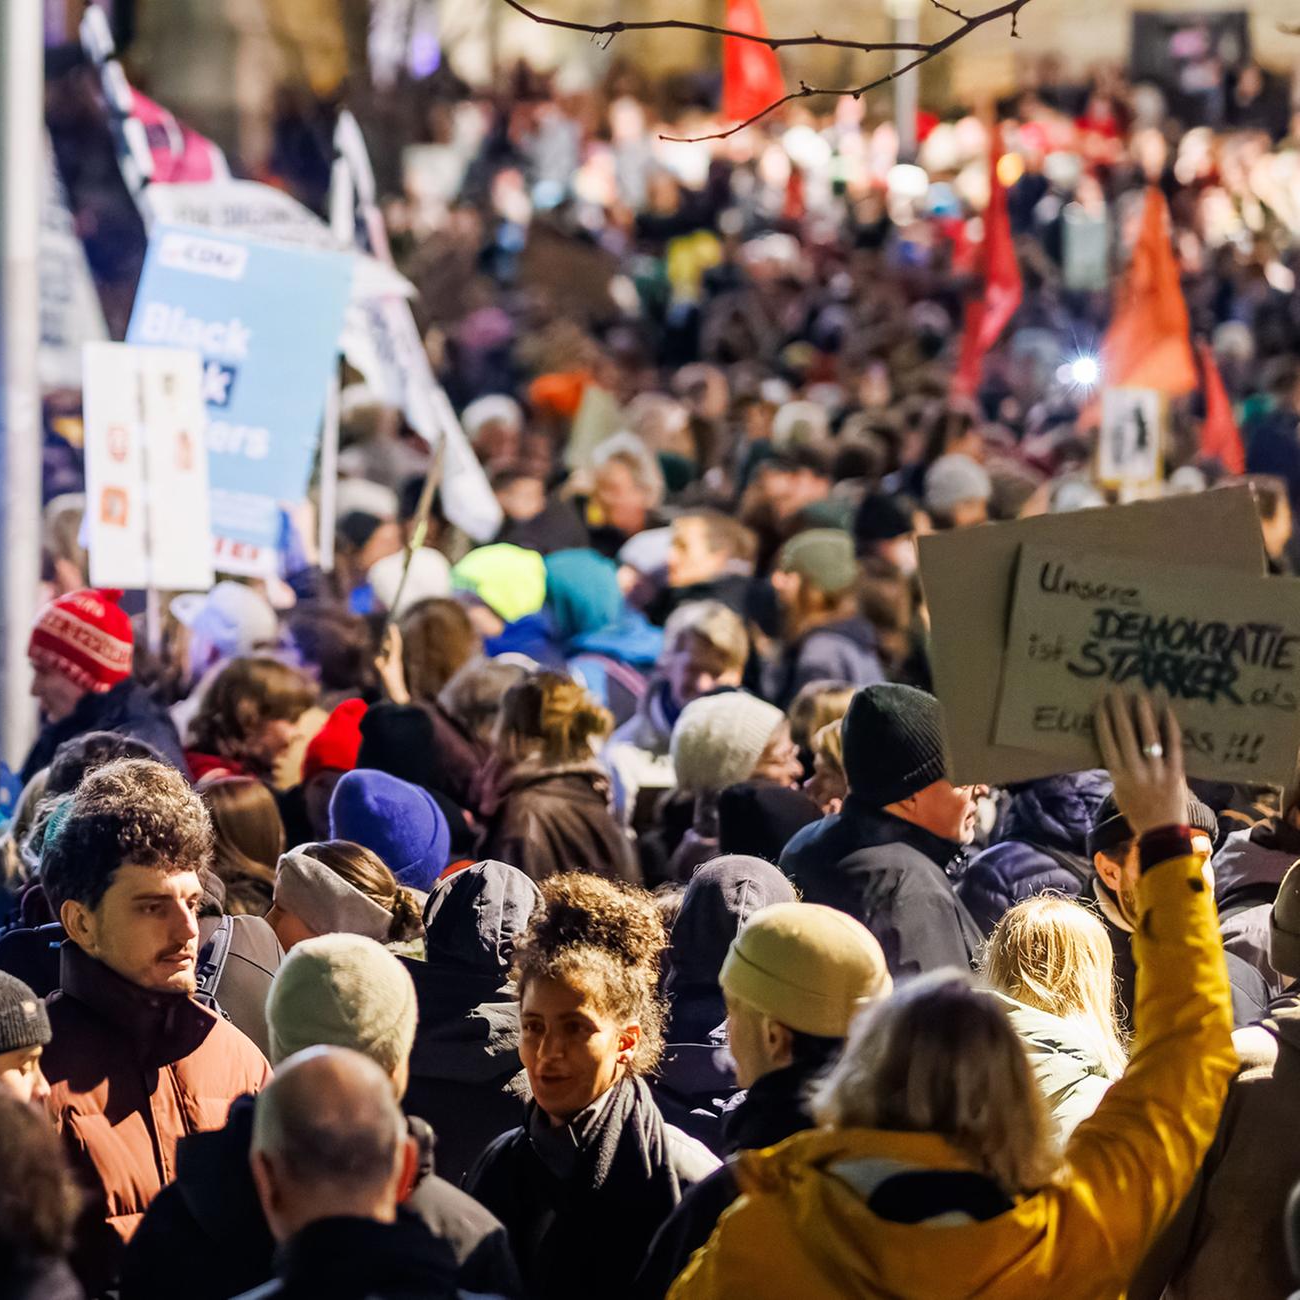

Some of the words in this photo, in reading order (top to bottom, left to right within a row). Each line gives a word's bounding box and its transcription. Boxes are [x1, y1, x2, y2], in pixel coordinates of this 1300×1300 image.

[142, 302, 252, 355] Black
[1039, 562, 1140, 604] Unsere
[1090, 607, 1300, 670] DEMOKRATIE
